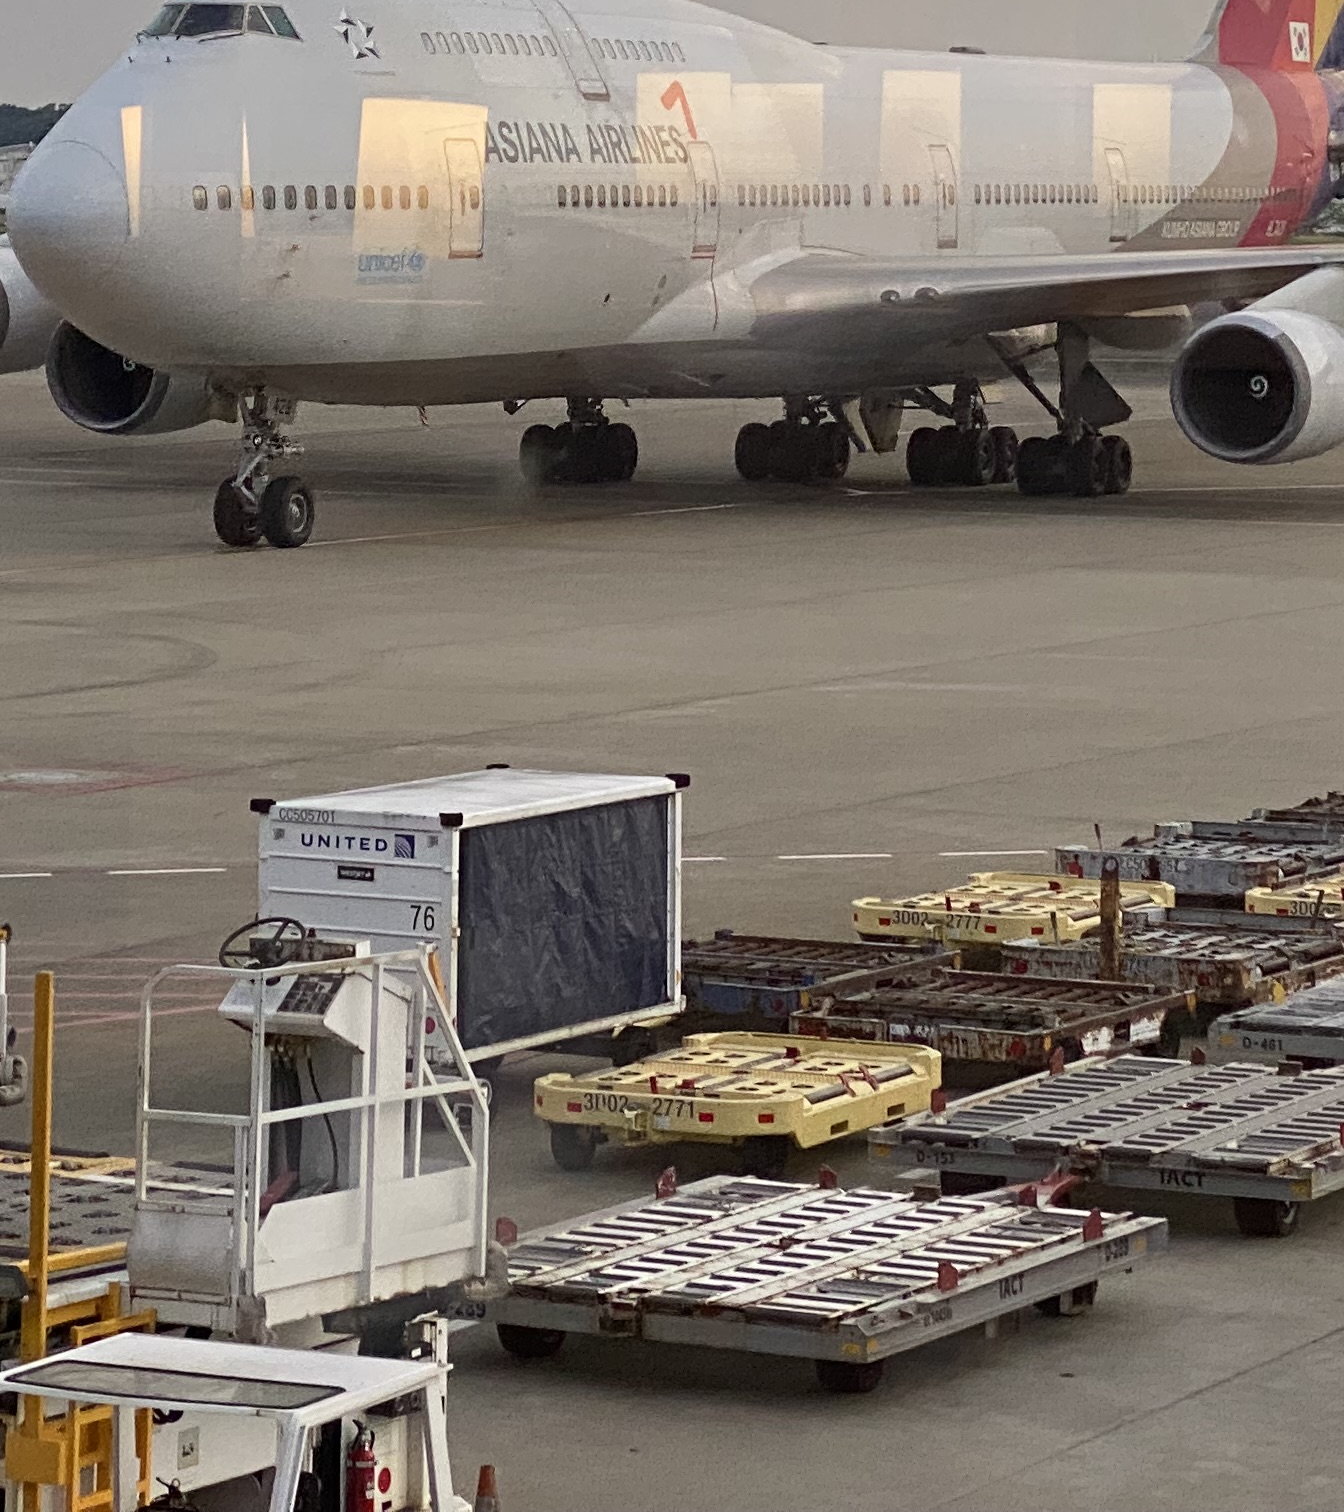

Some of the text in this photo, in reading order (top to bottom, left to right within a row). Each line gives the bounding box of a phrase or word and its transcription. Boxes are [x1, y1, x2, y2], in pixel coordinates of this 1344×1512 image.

[485, 121, 689, 164] ASIANA AIRLINES
[301, 833, 389, 852] UNITED
[410, 905, 436, 931] 76
[946, 914, 982, 929] 2777
[652, 1098, 694, 1119] 2771
[1160, 1168, 1206, 1187] IACT
